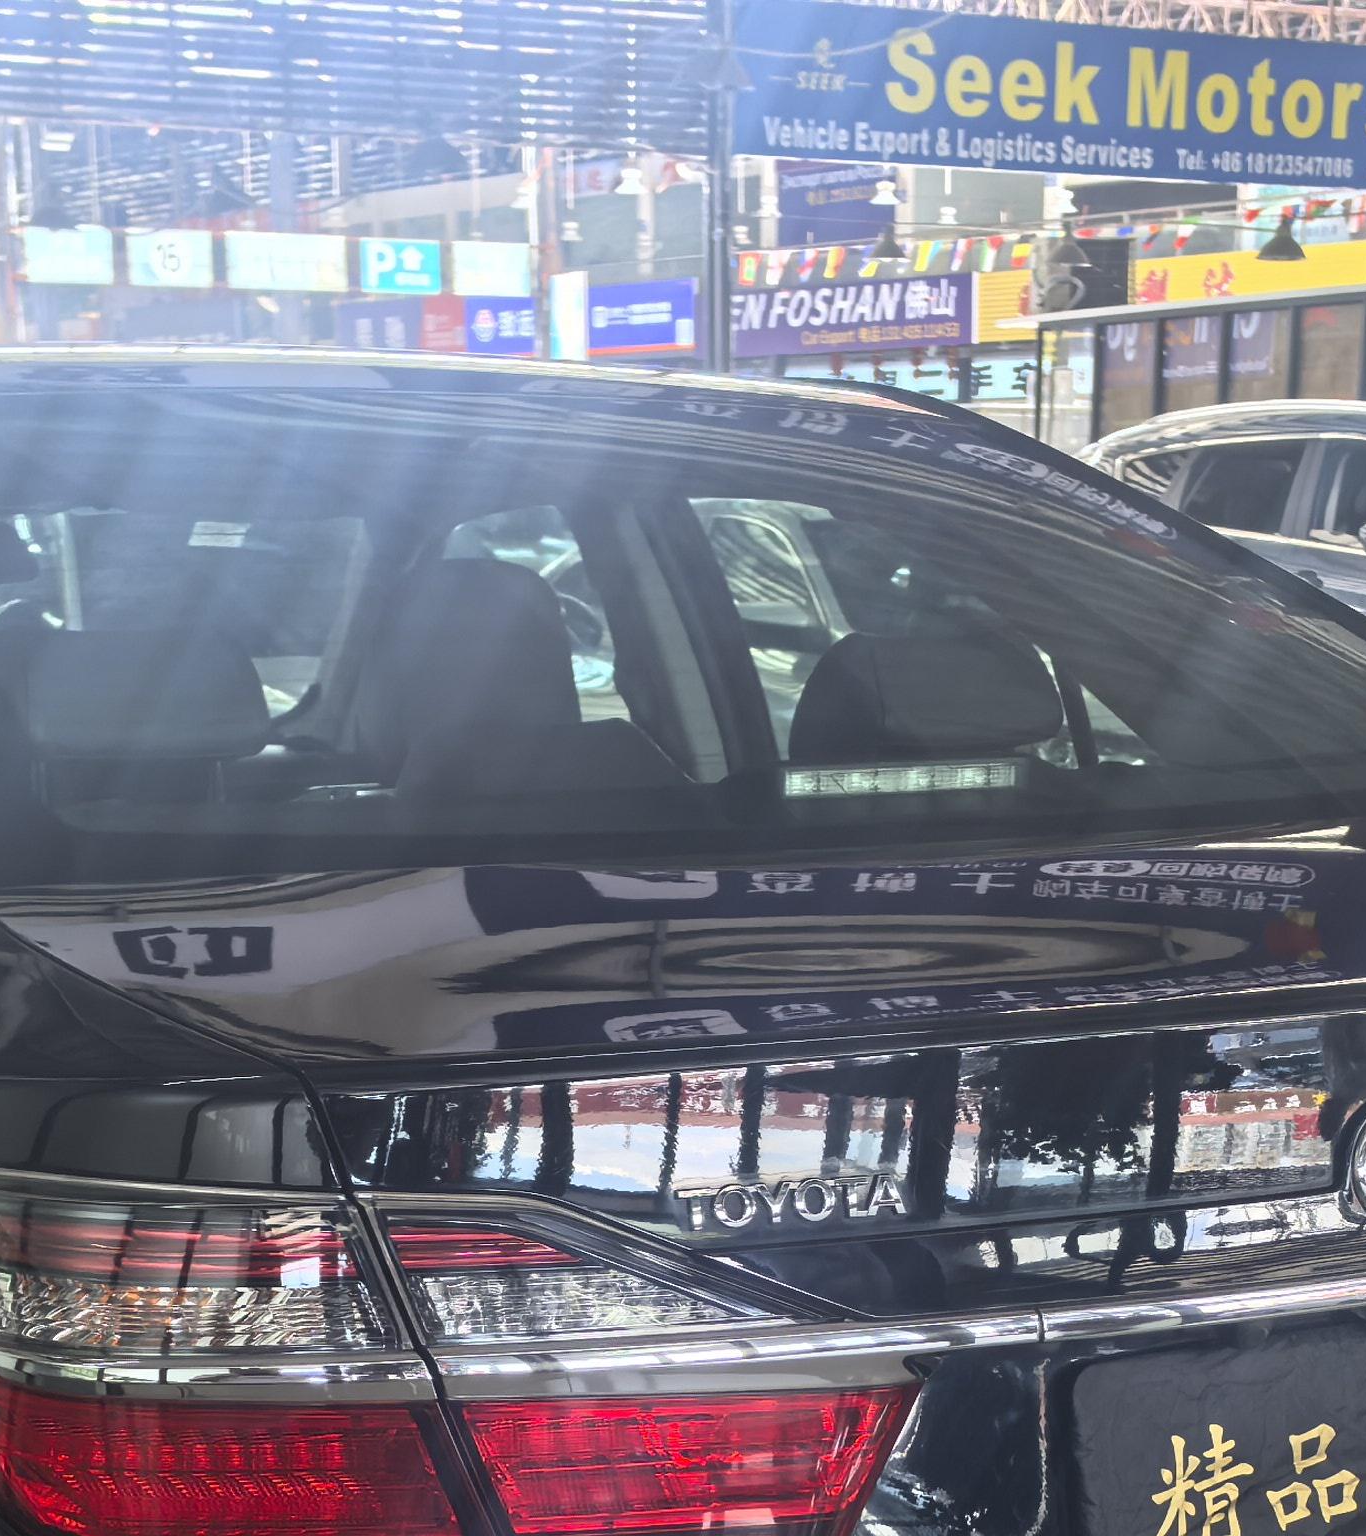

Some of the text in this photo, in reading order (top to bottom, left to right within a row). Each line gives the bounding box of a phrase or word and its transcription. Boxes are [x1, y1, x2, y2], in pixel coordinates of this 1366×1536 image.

[795, 70, 848, 92] SEEK
[885, 27, 1101, 125] Seek
[762, 115, 849, 151] Vehicle
[854, 121, 930, 161] Export
[935, 126, 953, 157] &
[957, 128, 1056, 167] Logistics
[1061, 134, 1154, 169] Services
[368, 242, 396, 288] P
[768, 282, 903, 330] FOSHAN
[675, 1173, 907, 1231] TOYOTA
